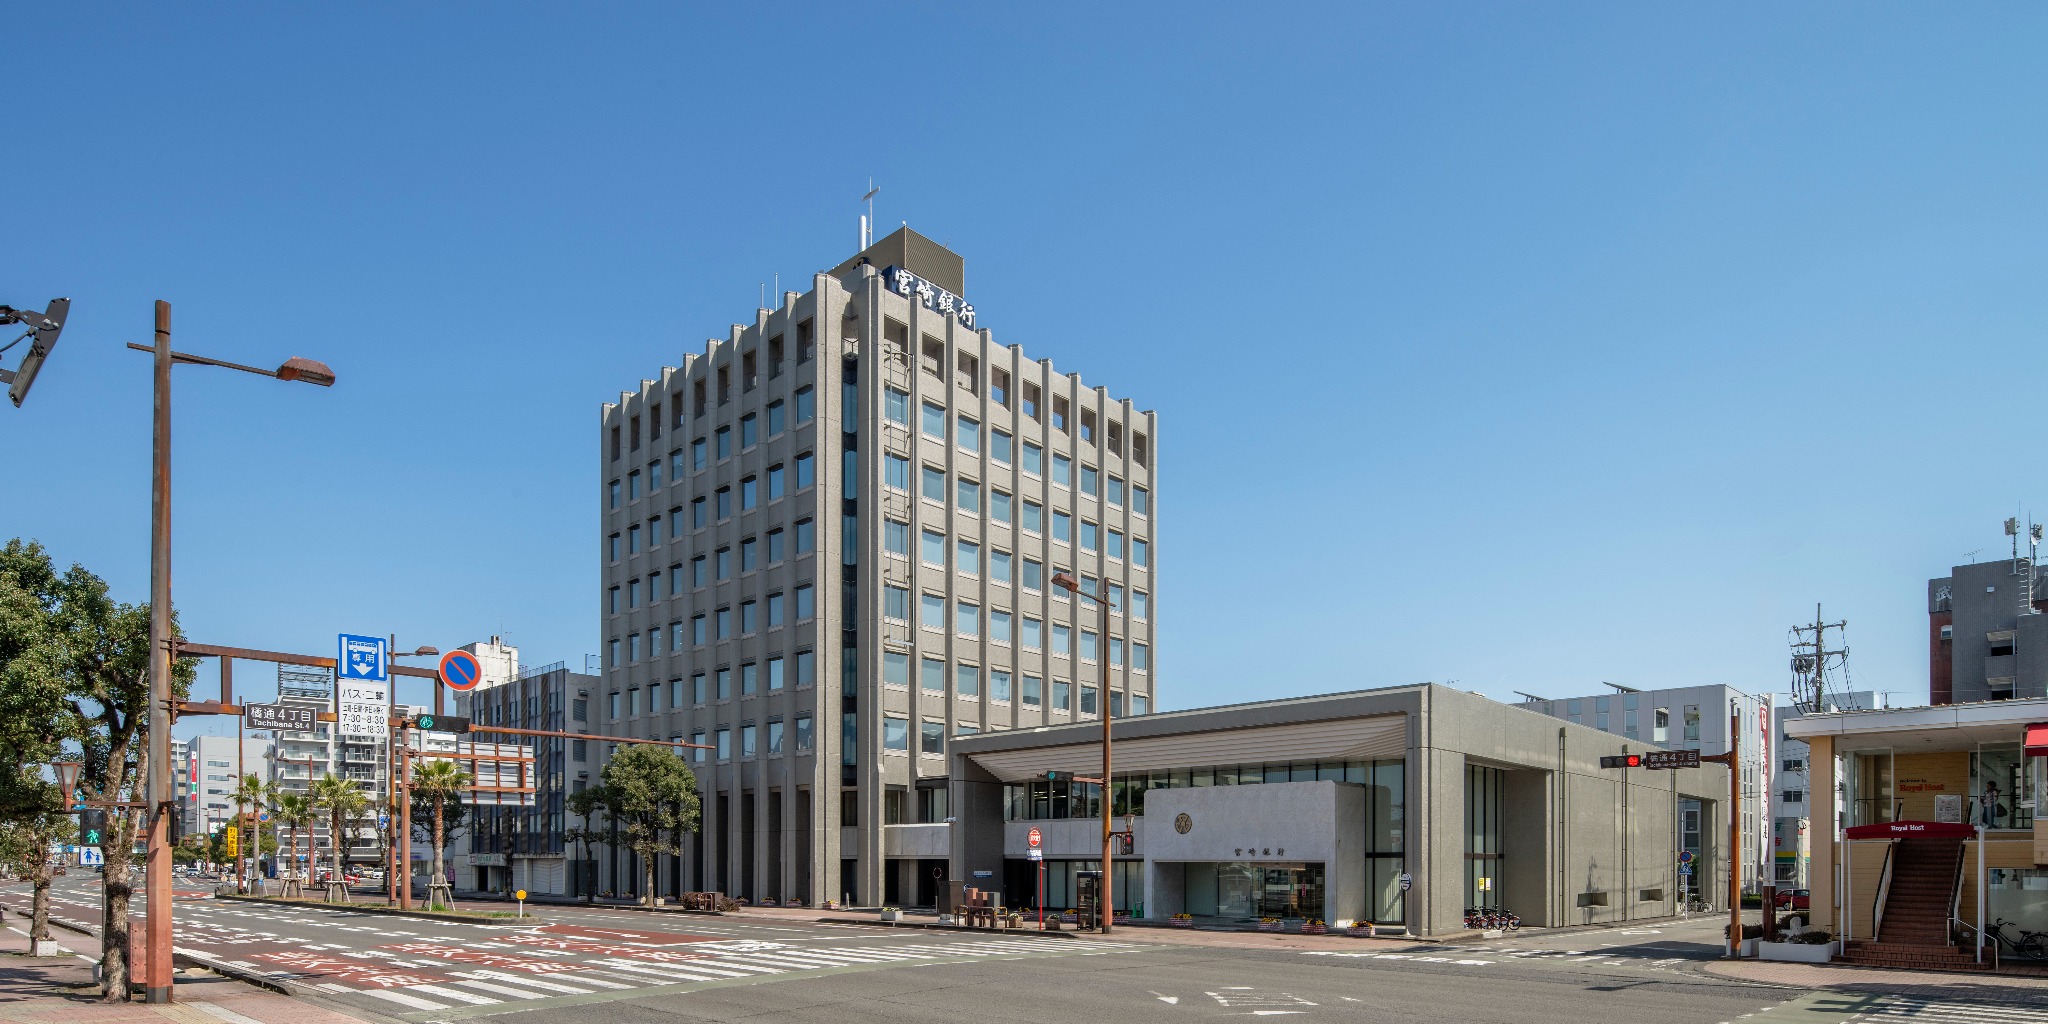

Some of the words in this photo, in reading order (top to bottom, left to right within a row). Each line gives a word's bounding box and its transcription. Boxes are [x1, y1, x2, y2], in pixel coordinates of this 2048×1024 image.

[895, 269, 975, 326] 宮崎銀行
[351, 653, 375, 664] 専用
[253, 719, 293, 728] Tachibana
[1899, 784, 1923, 793] Royal
[1924, 783, 1945, 791] Host
[1234, 848, 1285, 857] 宮崎銀行
